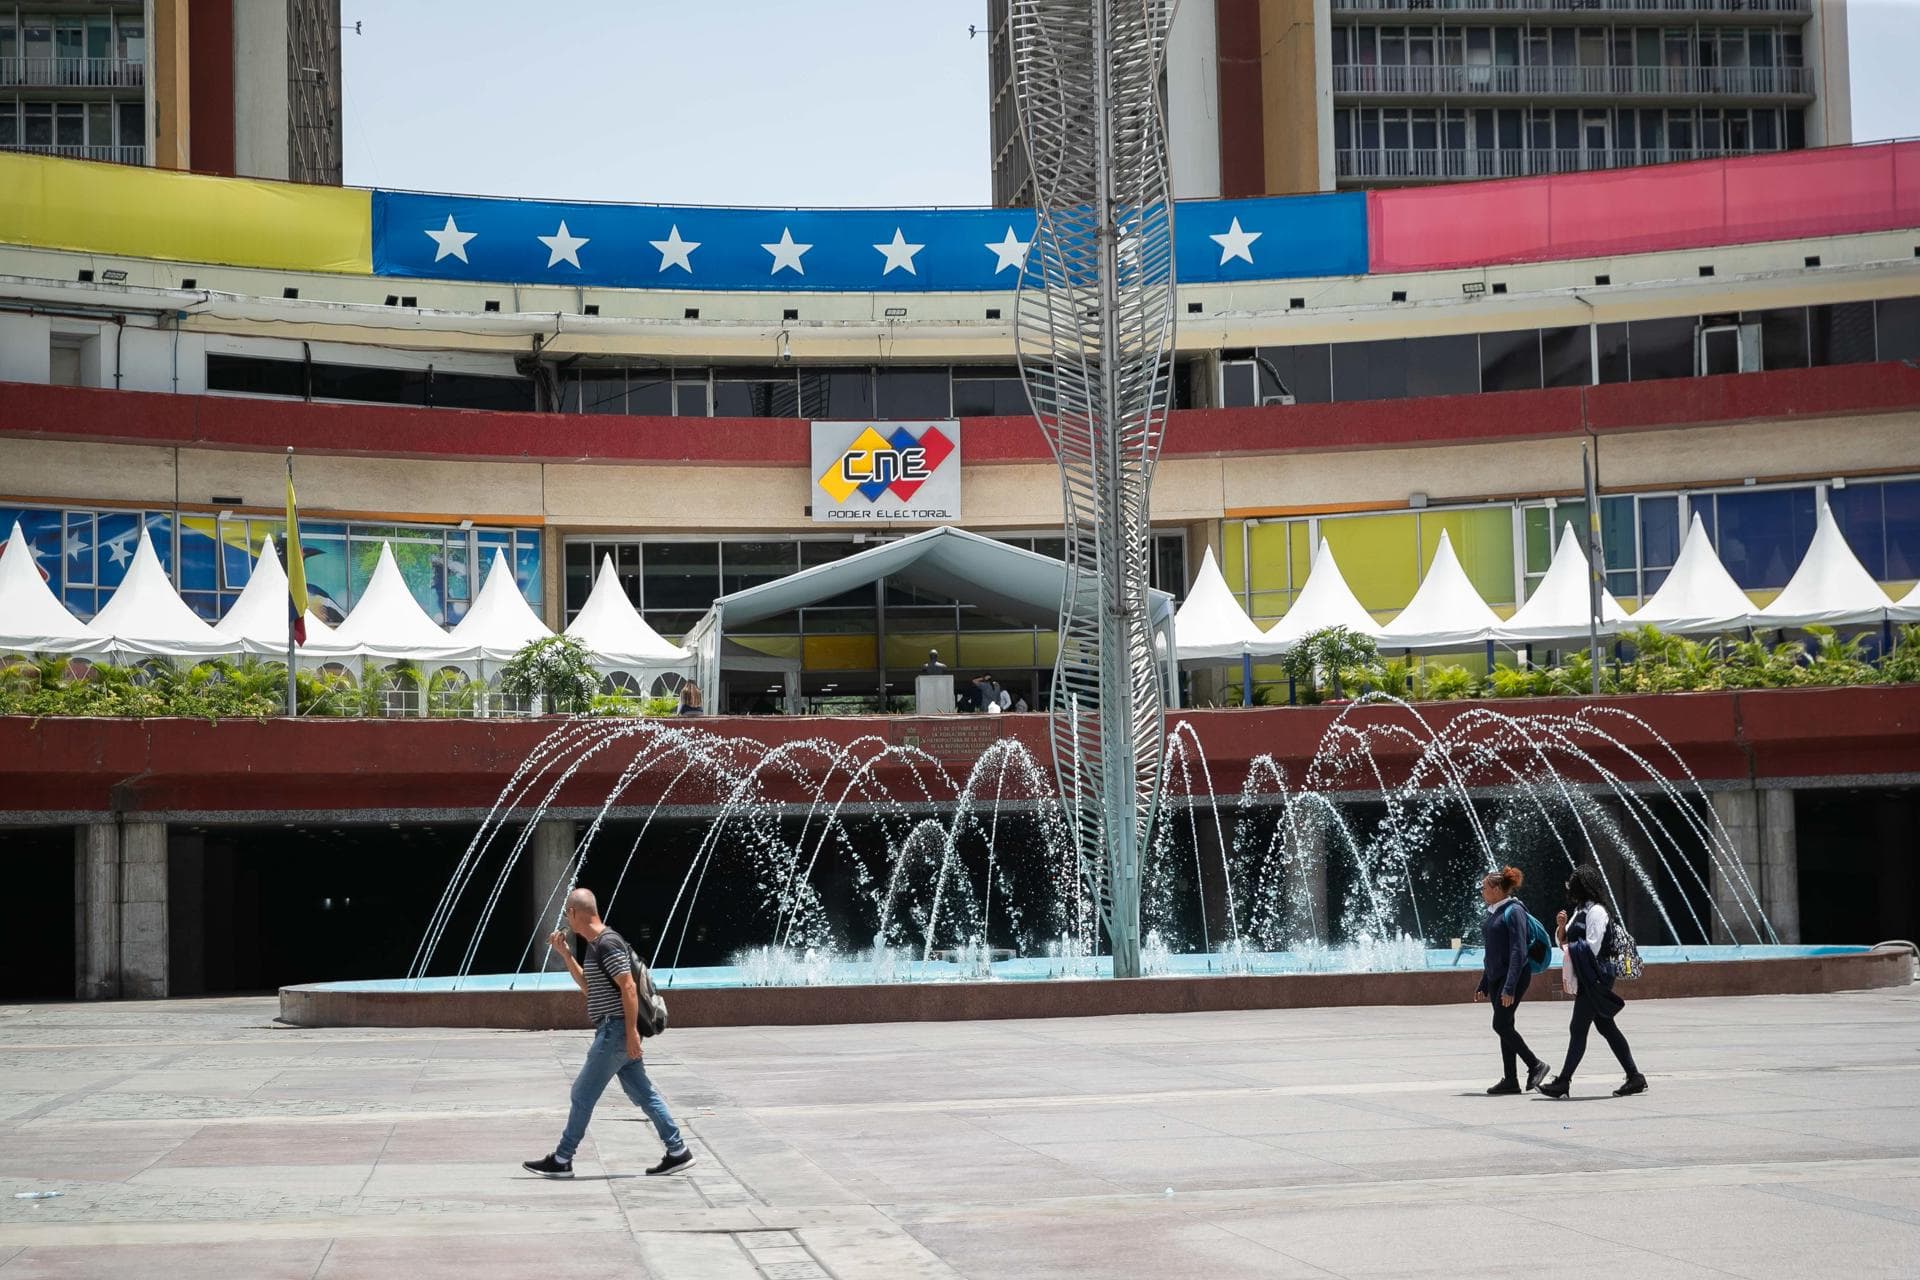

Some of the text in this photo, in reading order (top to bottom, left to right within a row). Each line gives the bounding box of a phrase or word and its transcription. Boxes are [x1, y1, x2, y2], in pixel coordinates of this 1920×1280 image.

[842, 448, 931, 483] CNE
[828, 509, 952, 519] PODER ELECTORAL
